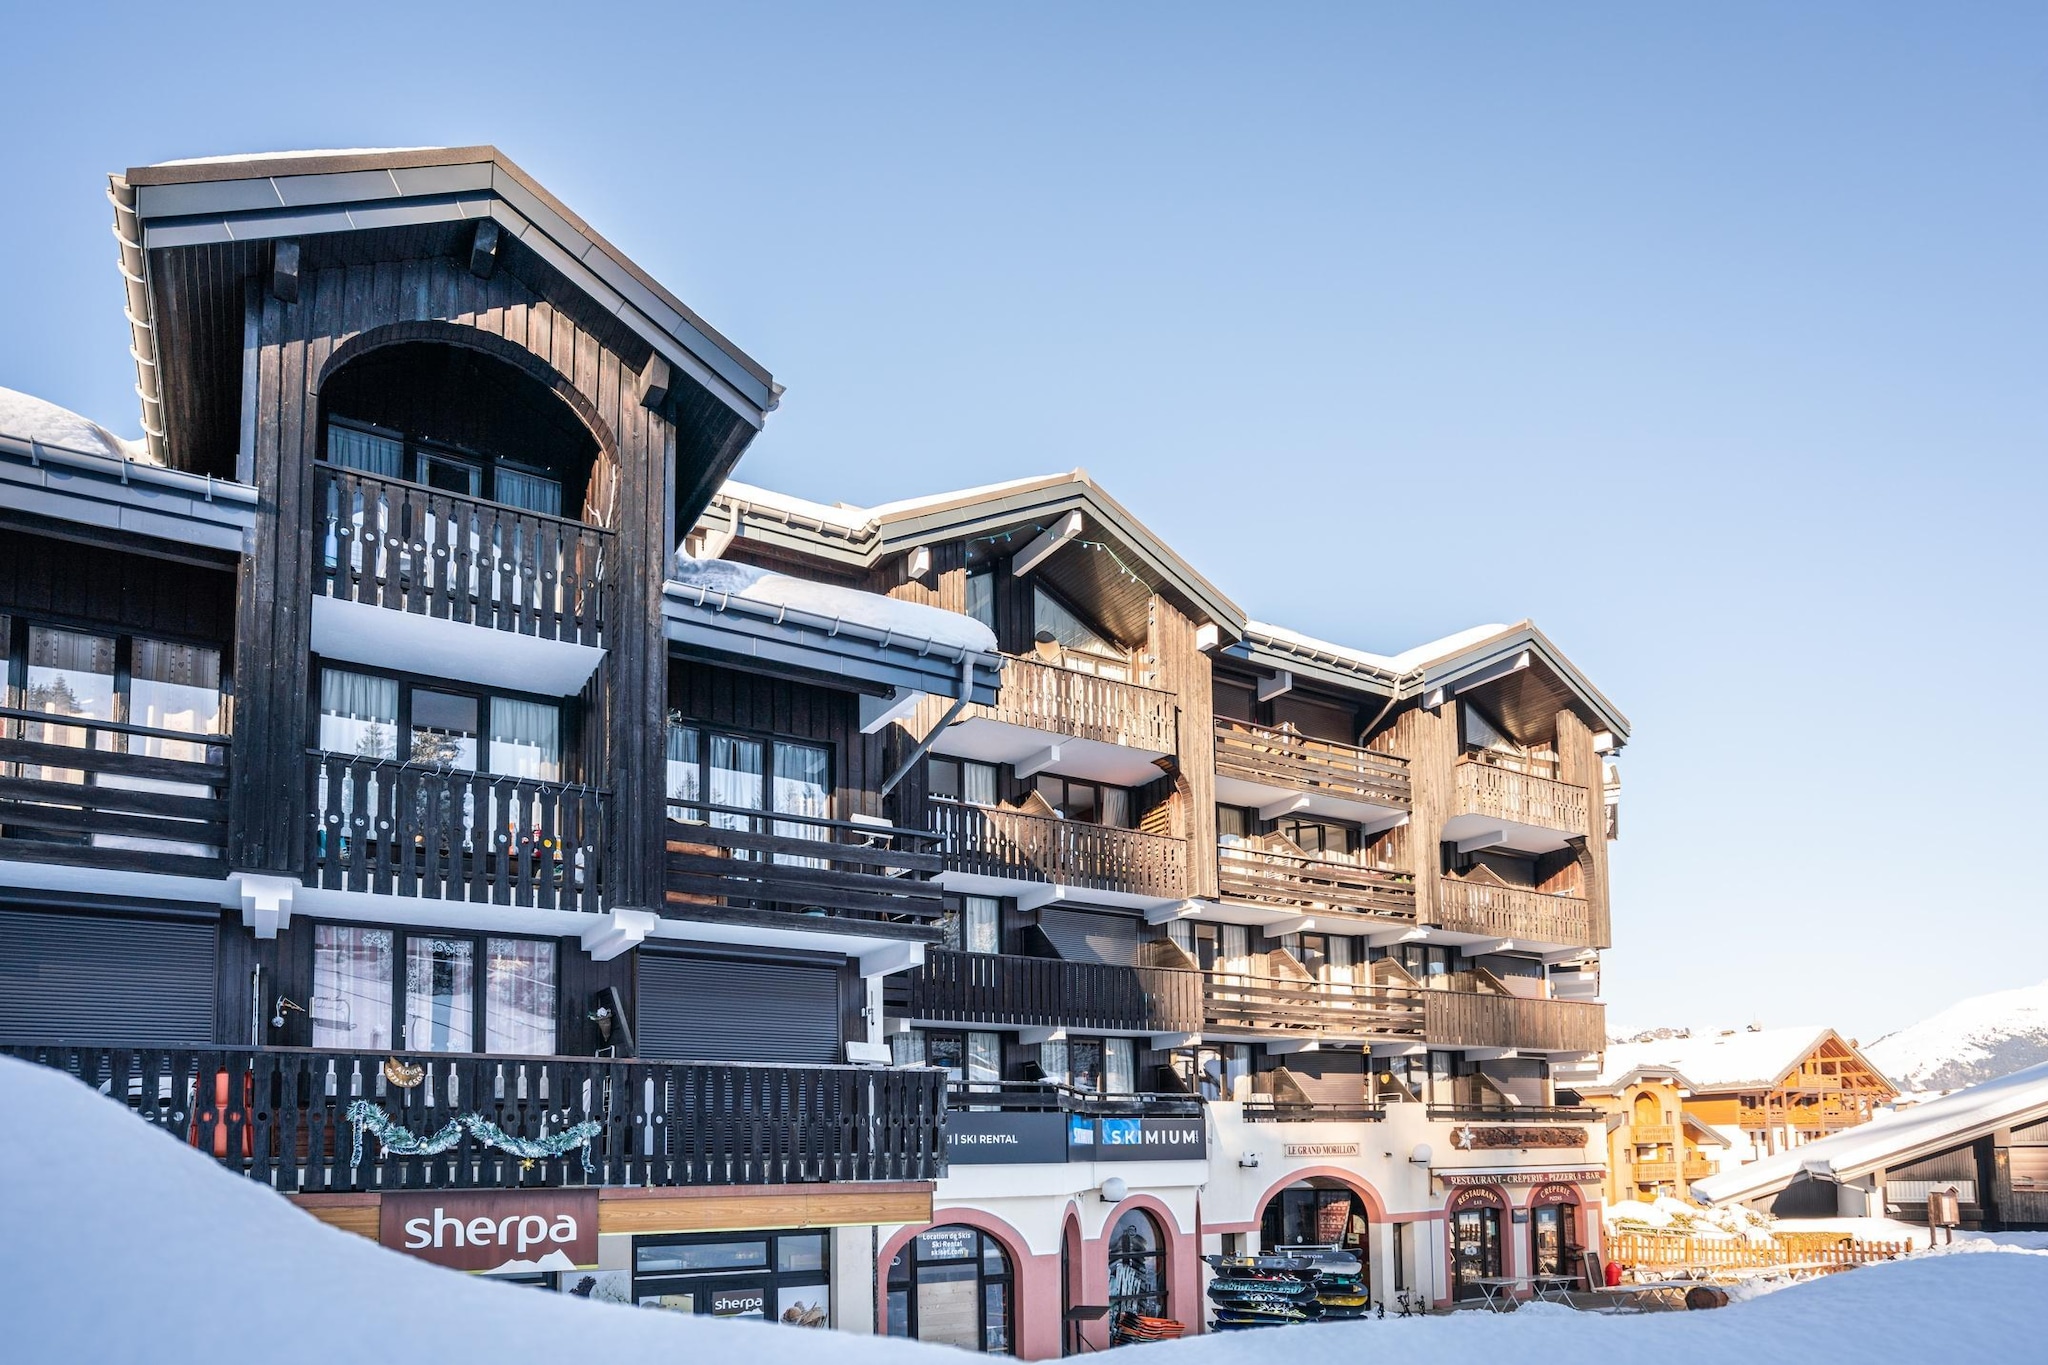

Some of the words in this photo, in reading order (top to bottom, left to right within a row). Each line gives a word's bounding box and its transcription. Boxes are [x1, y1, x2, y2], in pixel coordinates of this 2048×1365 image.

[401, 1066, 423, 1076] LOUER
[960, 1134, 977, 1144] SKI
[979, 1134, 1018, 1144] RENTAL
[1111, 1130, 1195, 1144] SKIMIUM
[1288, 1146, 1296, 1155] LE
[1297, 1145, 1321, 1155] GRAND
[1322, 1145, 1357, 1155] MORILLON
[1450, 1175, 1502, 1185] RESTAURANT
[1585, 1171, 1601, 1180] BAR
[1457, 1188, 1498, 1206] RESTAURANT
[404, 1207, 577, 1253] sherpa
[922, 1232, 949, 1240] Location
[942, 1240, 963, 1248] Rental
[714, 1297, 763, 1311] sherpa
